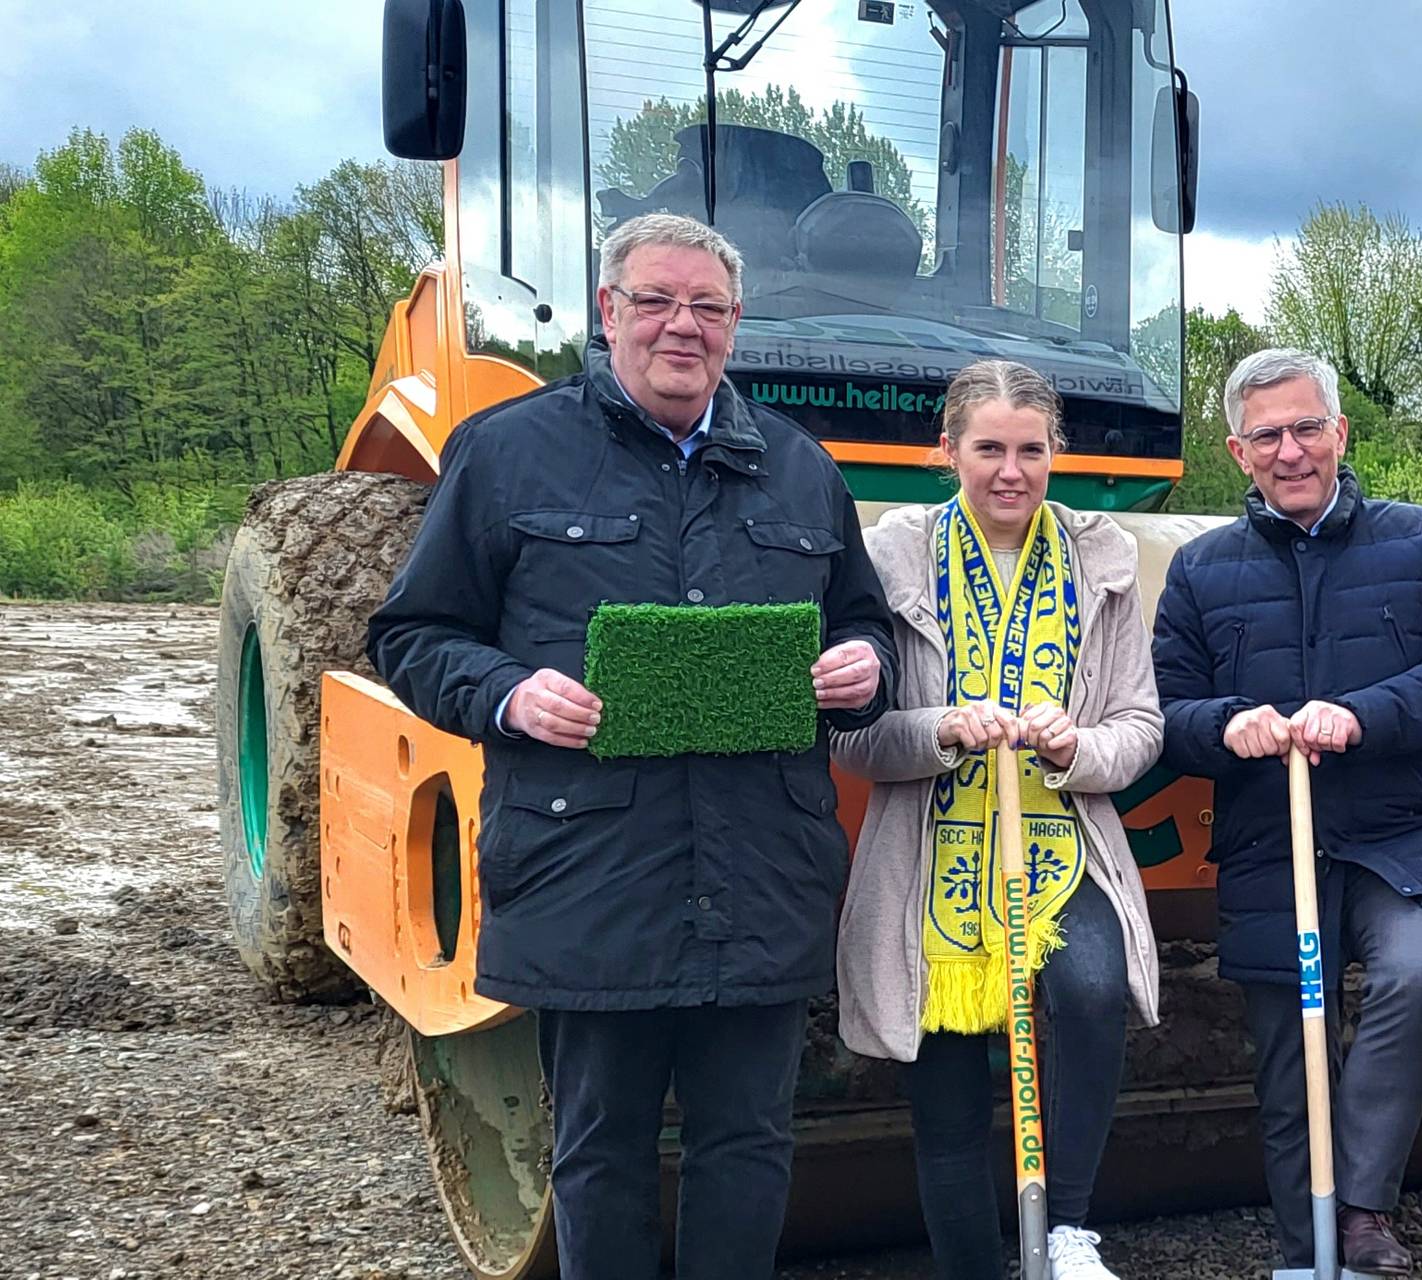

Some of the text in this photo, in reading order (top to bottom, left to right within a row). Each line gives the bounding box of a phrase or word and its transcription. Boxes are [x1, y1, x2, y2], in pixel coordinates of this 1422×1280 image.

[1005, 586, 1033, 658] IMMER
[1000, 666, 1021, 716] ÖFT
[1030, 642, 1065, 701] 67
[939, 828, 966, 846] SCC
[1028, 821, 1073, 839] HAGEN
[1298, 931, 1323, 1009] HEG
[1005, 877, 1044, 1173] www.heiler-sport.de
